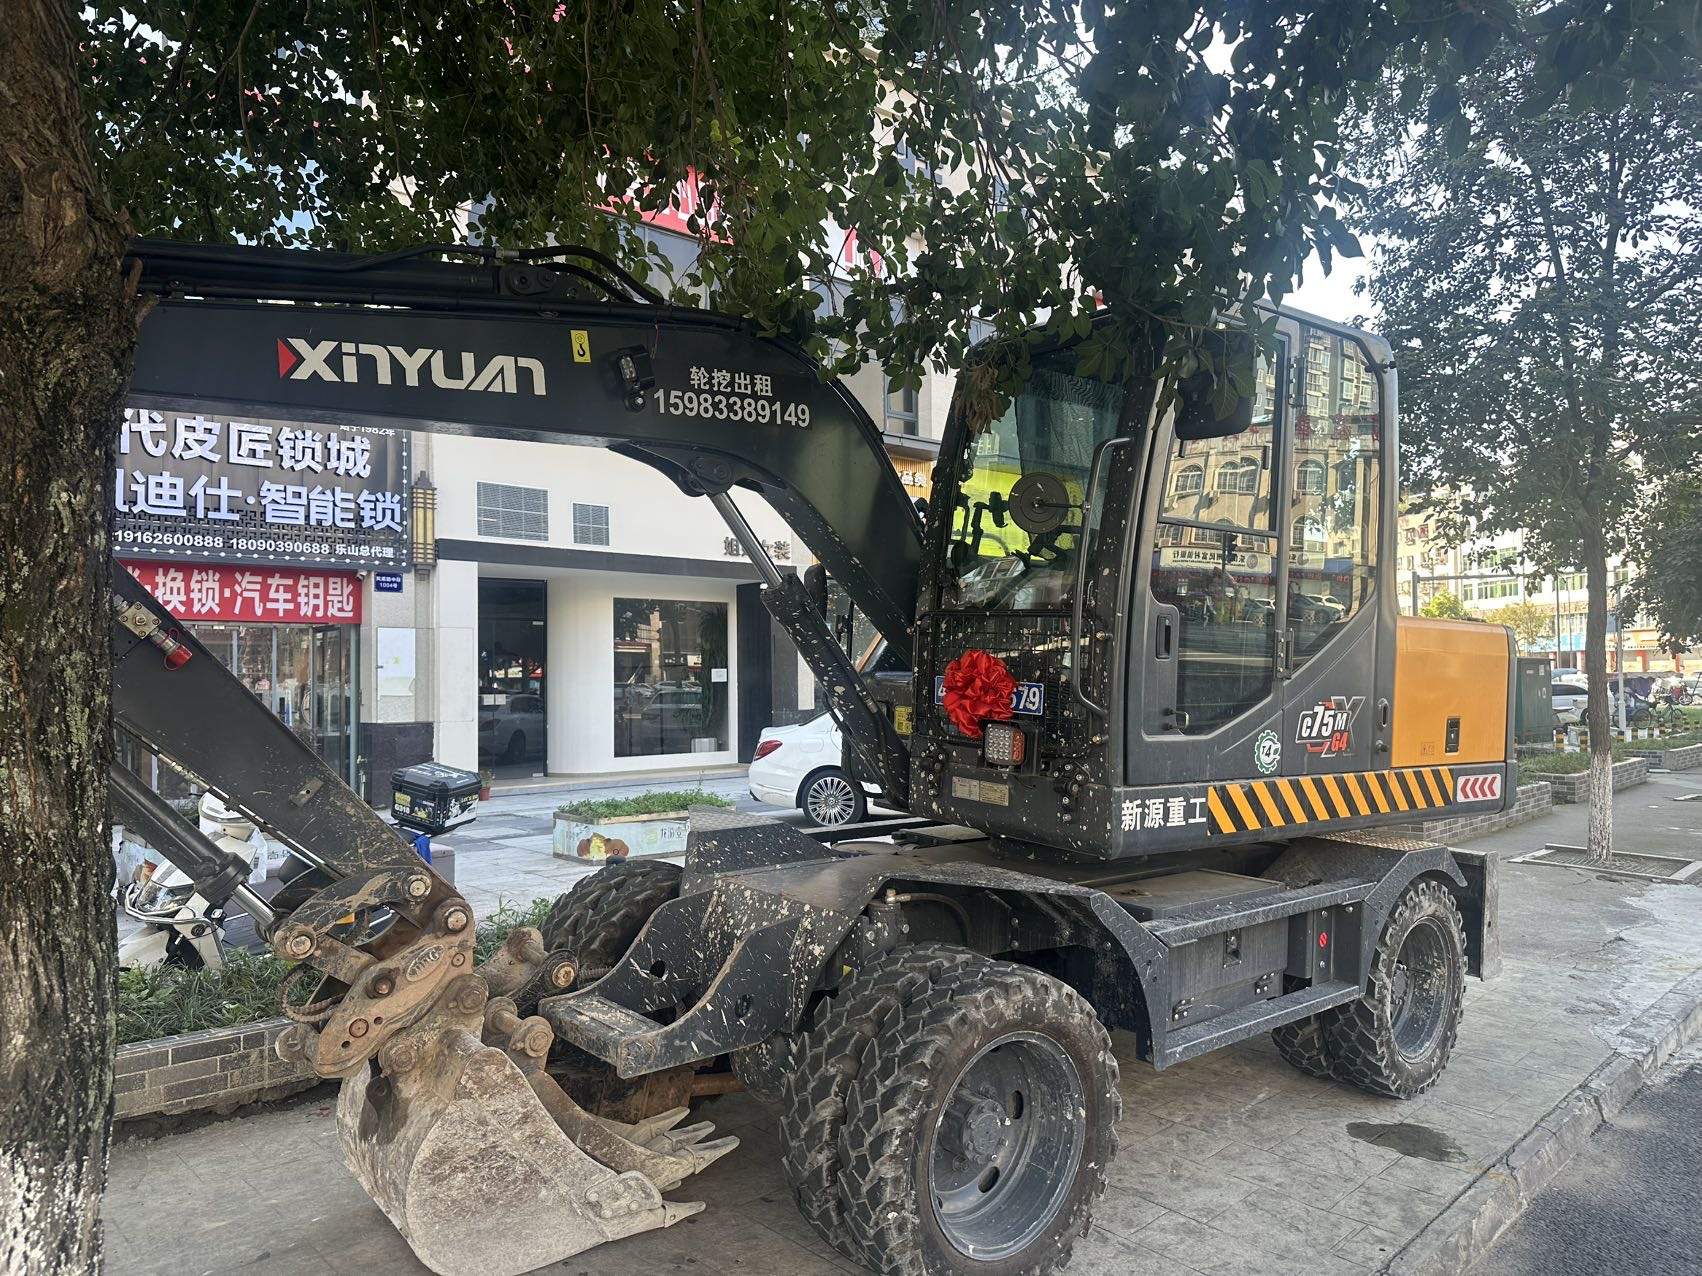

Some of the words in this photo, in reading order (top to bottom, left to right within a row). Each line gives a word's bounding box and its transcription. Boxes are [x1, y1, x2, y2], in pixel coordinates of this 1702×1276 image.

[689, 366, 773, 397] 轮挖出租
[653, 388, 810, 427] 15983389149
[230, 538, 330, 555] 18090390688
[335, 544, 394, 558] 乐山总代理
[1121, 796, 1207, 832] 新源重工
